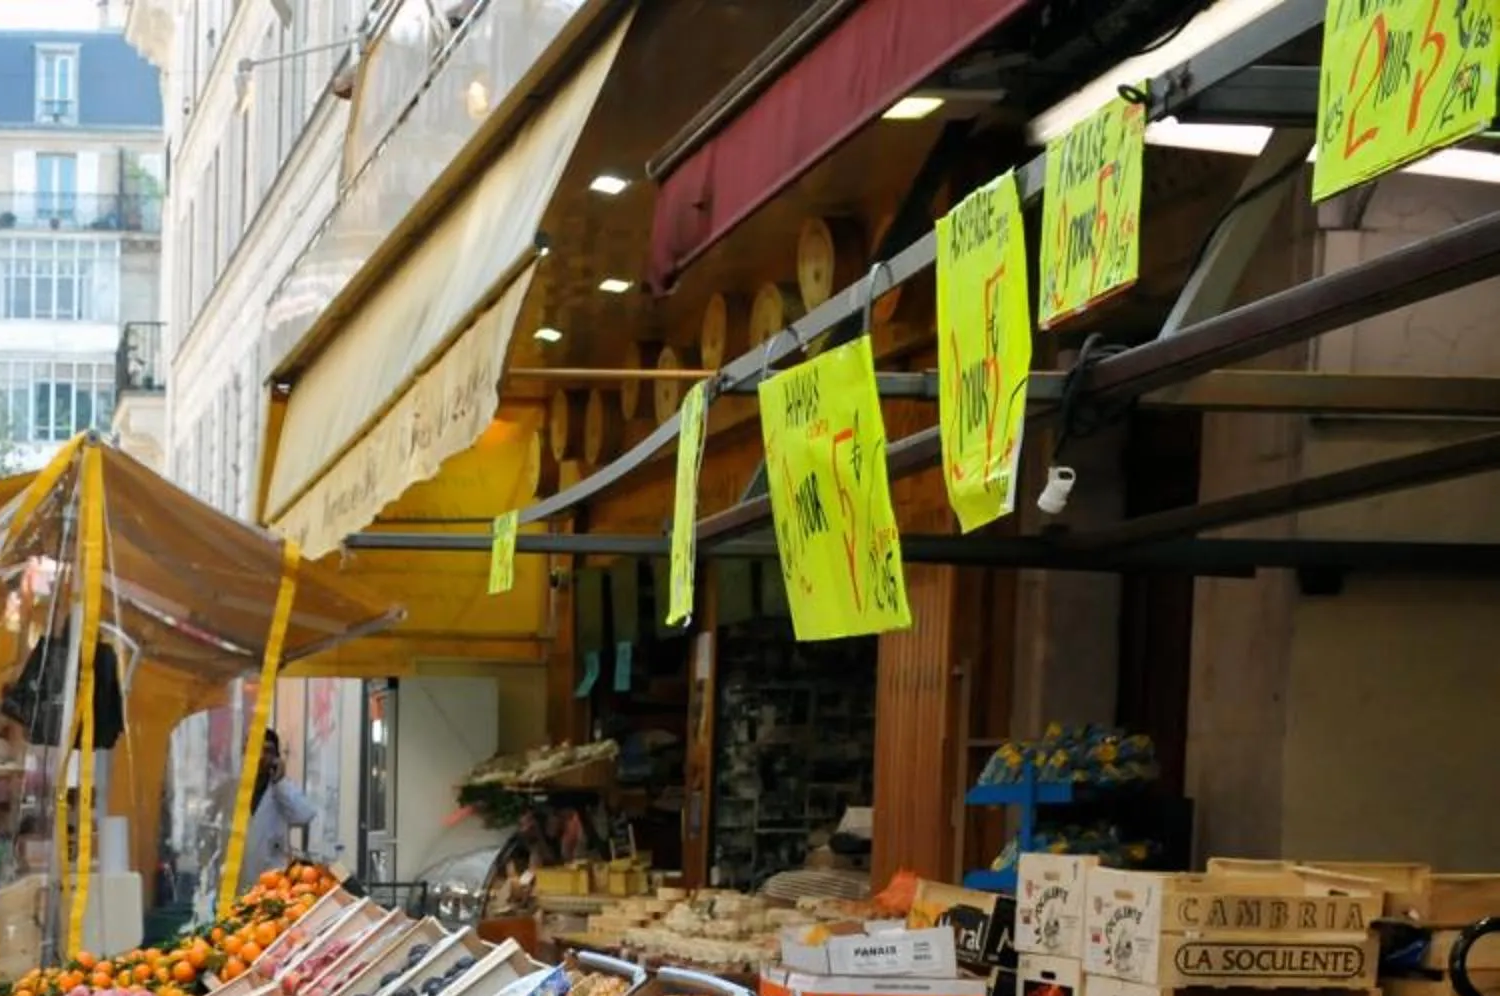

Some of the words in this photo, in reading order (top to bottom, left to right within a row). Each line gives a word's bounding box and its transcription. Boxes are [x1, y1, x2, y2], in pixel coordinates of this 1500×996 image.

[1177, 897, 1366, 930] CAMBRIA
[1183, 949, 1212, 970] LA
[1221, 948, 1355, 972] SOCULENTE
